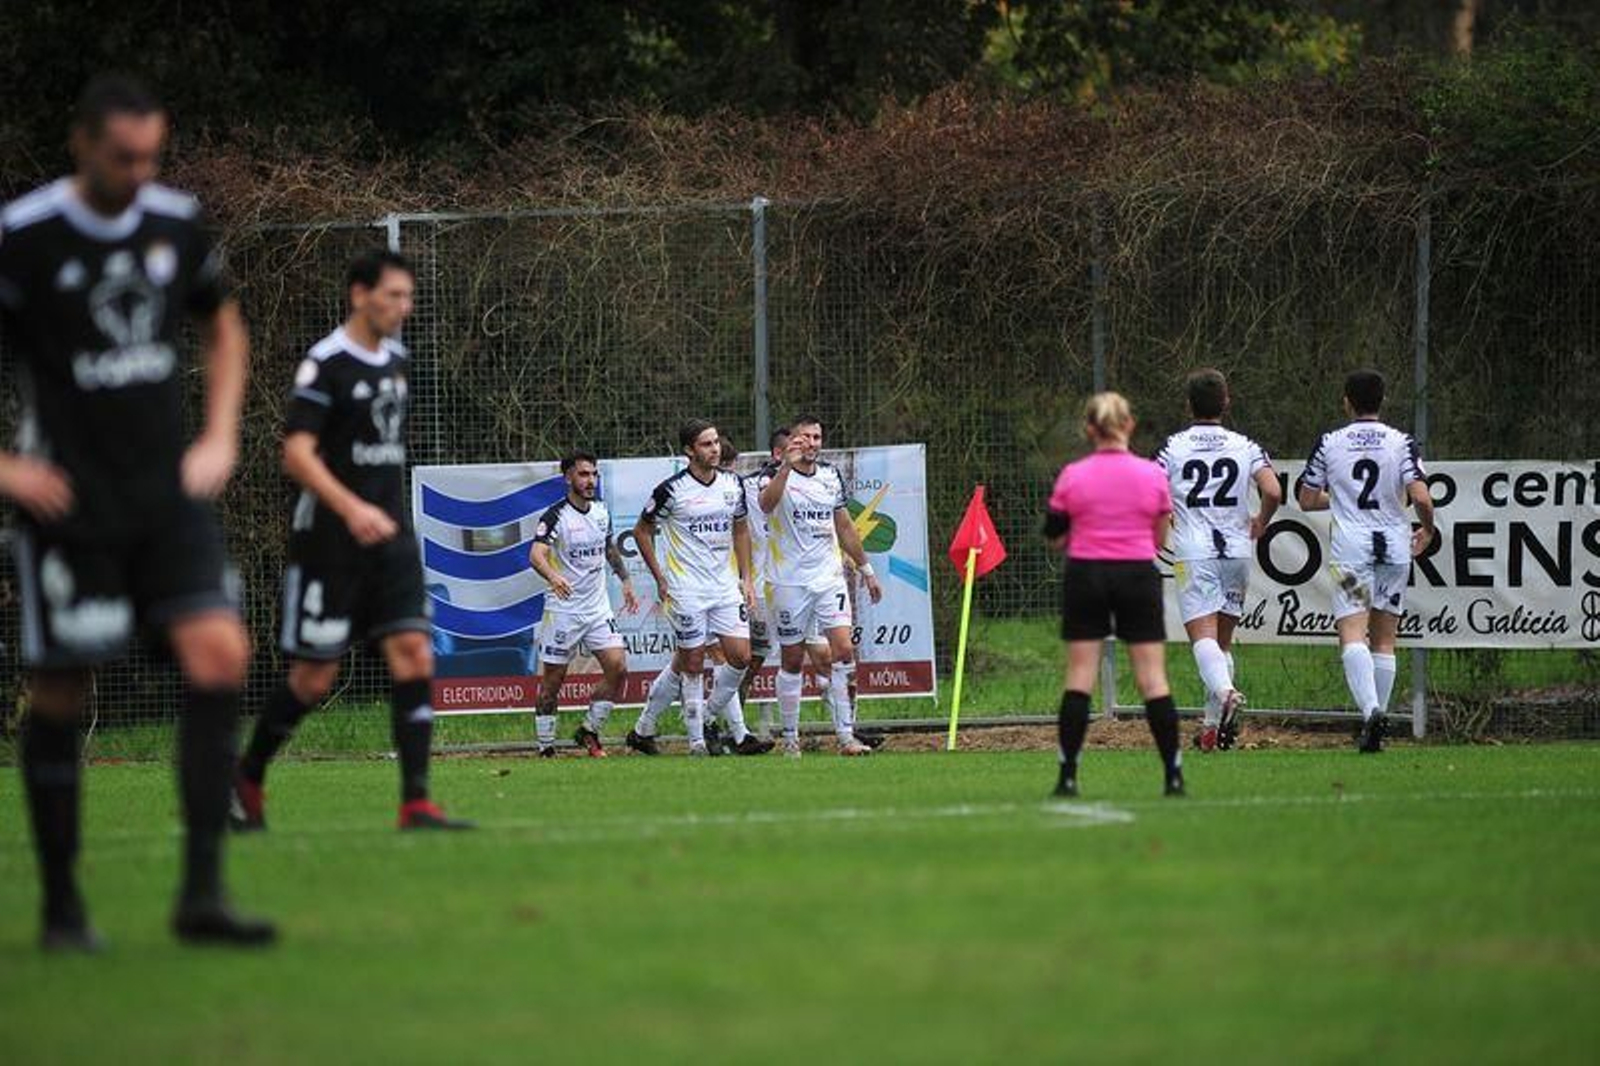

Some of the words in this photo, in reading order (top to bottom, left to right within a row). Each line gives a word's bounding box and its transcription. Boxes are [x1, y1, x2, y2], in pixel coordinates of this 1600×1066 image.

[1182, 457, 1239, 508] 22
[1352, 459, 1380, 510] 2
[835, 593, 846, 611] 7
[1428, 605, 1458, 634] de
[1467, 599, 1569, 635] Galicia
[875, 624, 912, 645] 210
[868, 668, 911, 687] MÓVIL
